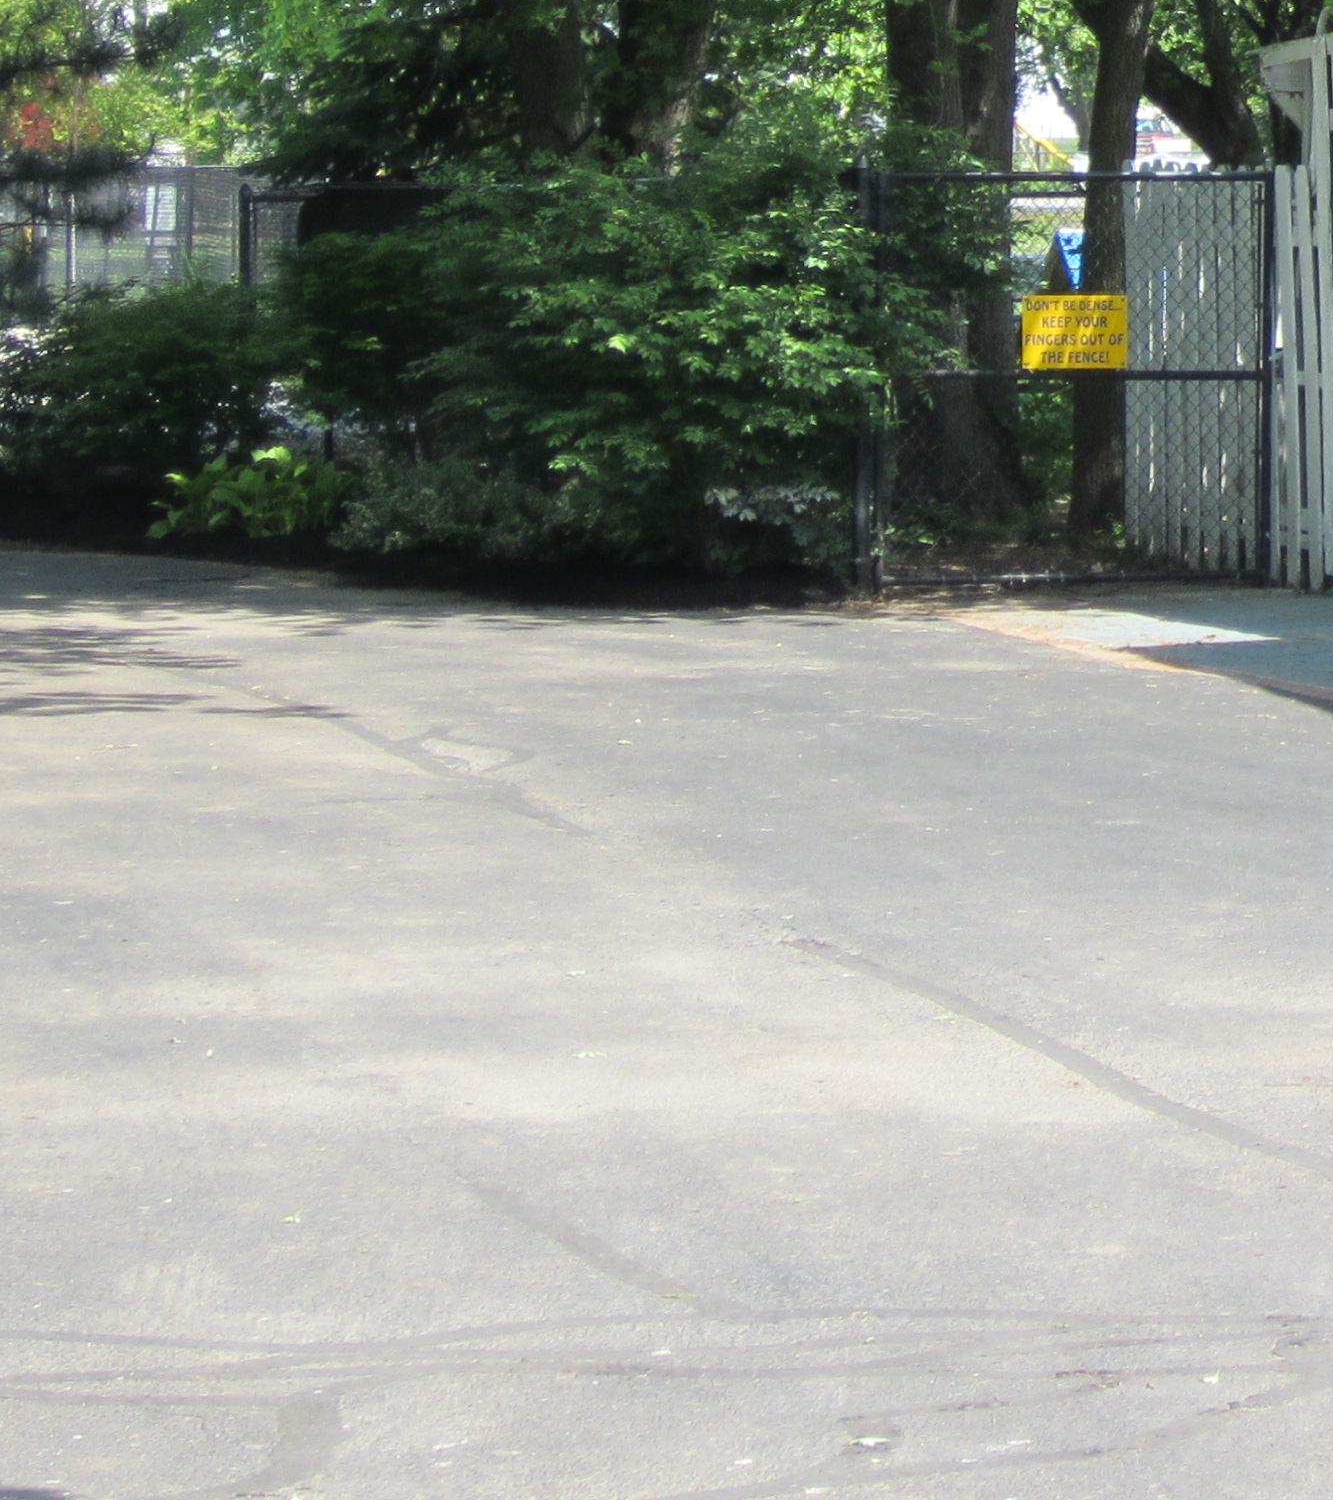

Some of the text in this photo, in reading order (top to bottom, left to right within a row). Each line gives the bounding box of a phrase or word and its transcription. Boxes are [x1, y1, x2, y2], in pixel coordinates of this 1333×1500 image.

[1026, 300, 1060, 311] DON'T
[1063, 300, 1075, 311] BE
[1042, 316, 1107, 328] KEEP YOUR
[1025, 334, 1124, 346] FINGERS OUT OF
[1041, 351, 1109, 363] THE FENCE!
